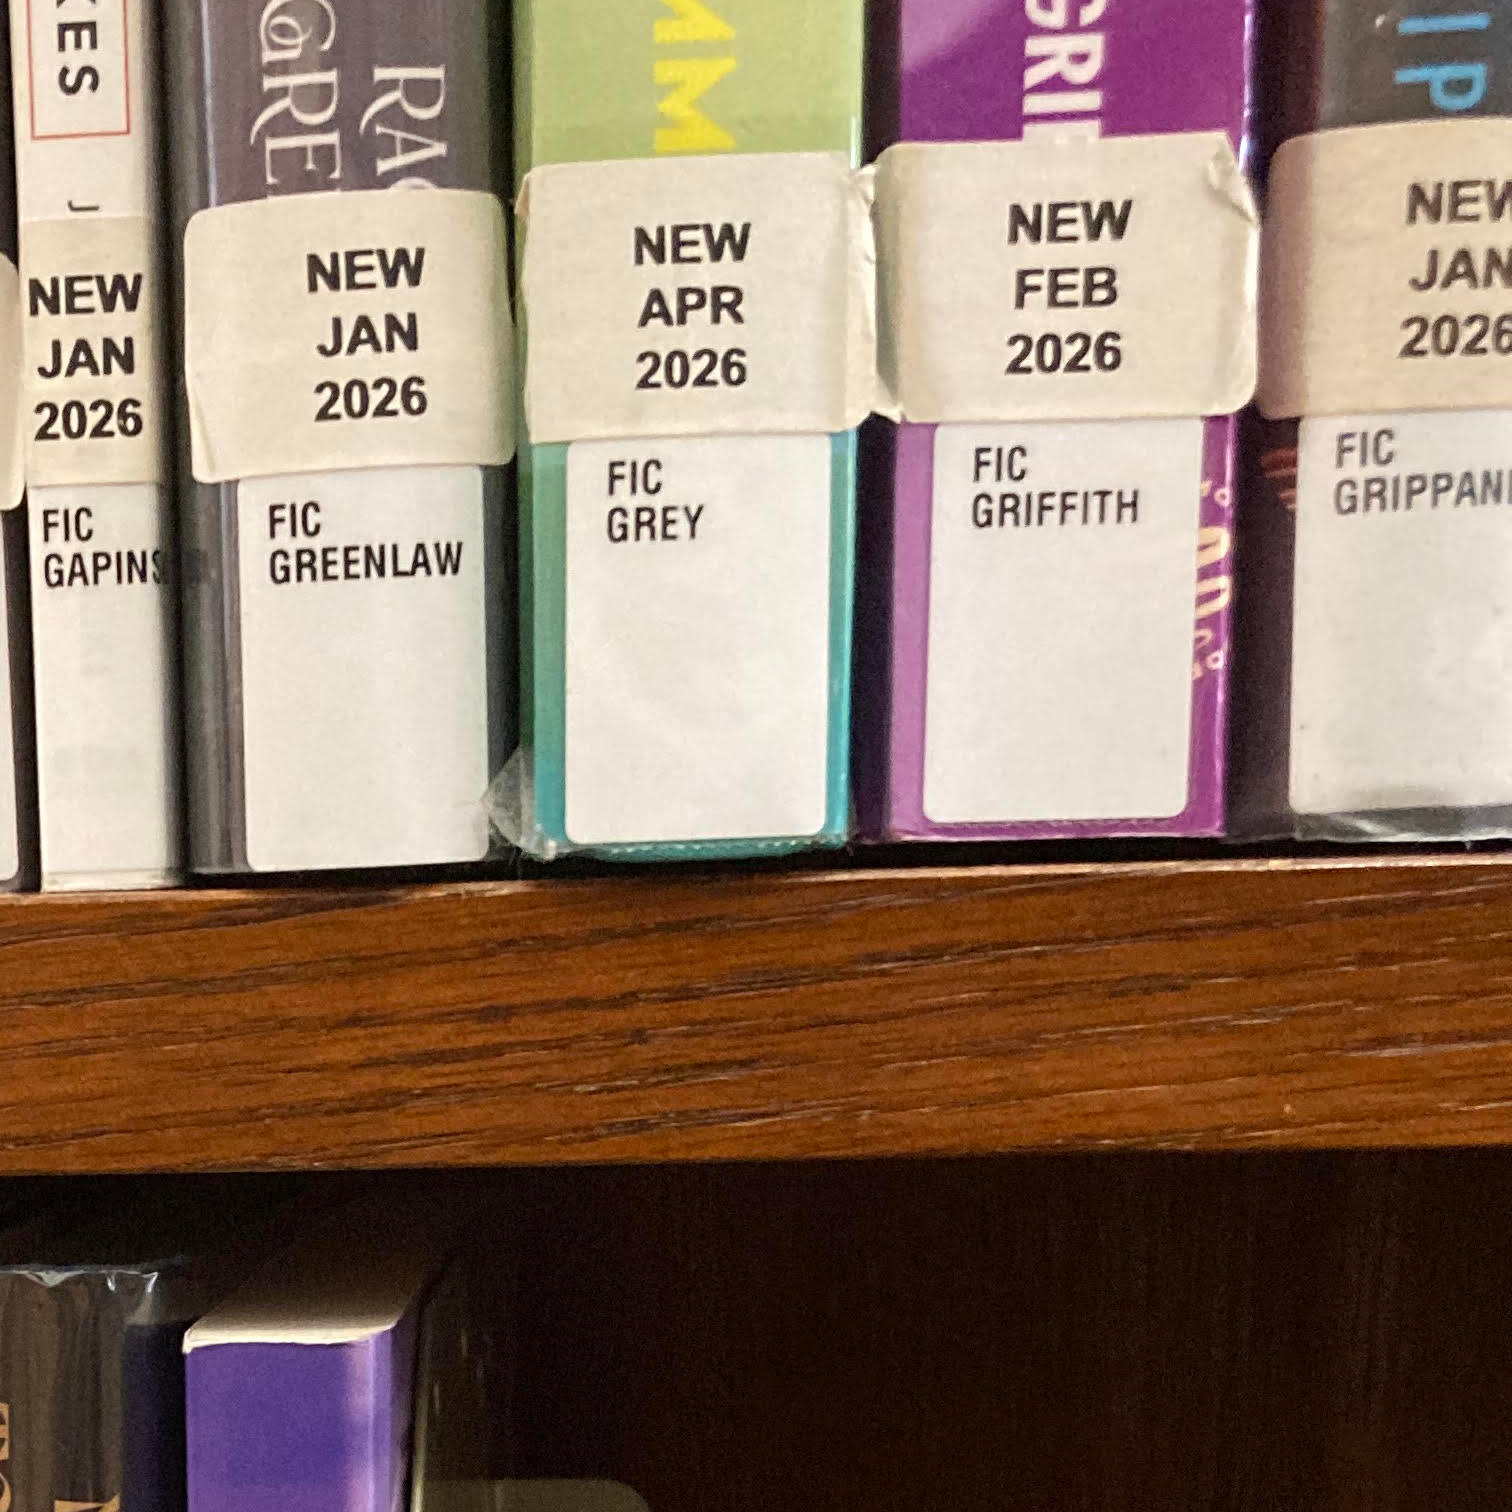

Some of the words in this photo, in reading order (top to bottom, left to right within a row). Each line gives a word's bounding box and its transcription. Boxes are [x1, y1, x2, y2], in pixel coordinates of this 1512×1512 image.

[57, 0, 100, 97] ES
[250, 0, 341, 197] GRE
[360, 64, 447, 190] RA
[1007, 199, 1132, 245] NEW
[1406, 179, 1512, 226] NEW
[633, 222, 751, 267] NEW
[306, 247, 426, 294] NEW
[1014, 266, 1118, 310] FEB
[1408, 247, 1512, 291] JAN
[28, 273, 143, 317] NEW
[638, 285, 744, 329] APR
[316, 312, 419, 357] JAN
[1005, 331, 1122, 375] 2026
[1397, 313, 1512, 358] 2026
[37, 337, 135, 379] JAN
[635, 347, 747, 390] 2026
[33, 398, 144, 442] 2026
[313, 375, 428, 422] 2026
[972, 445, 1028, 484] FIC
[1334, 428, 1394, 470] FIC
[607, 459, 663, 497] FIC
[1333, 466, 1512, 516] GRIPPAN
[43, 506, 94, 542] FIC
[267, 501, 321, 538] FIC
[607, 504, 704, 545] GREY
[972, 489, 1139, 529] GRIFFITH
[269, 540, 463, 585] GREENLAW
